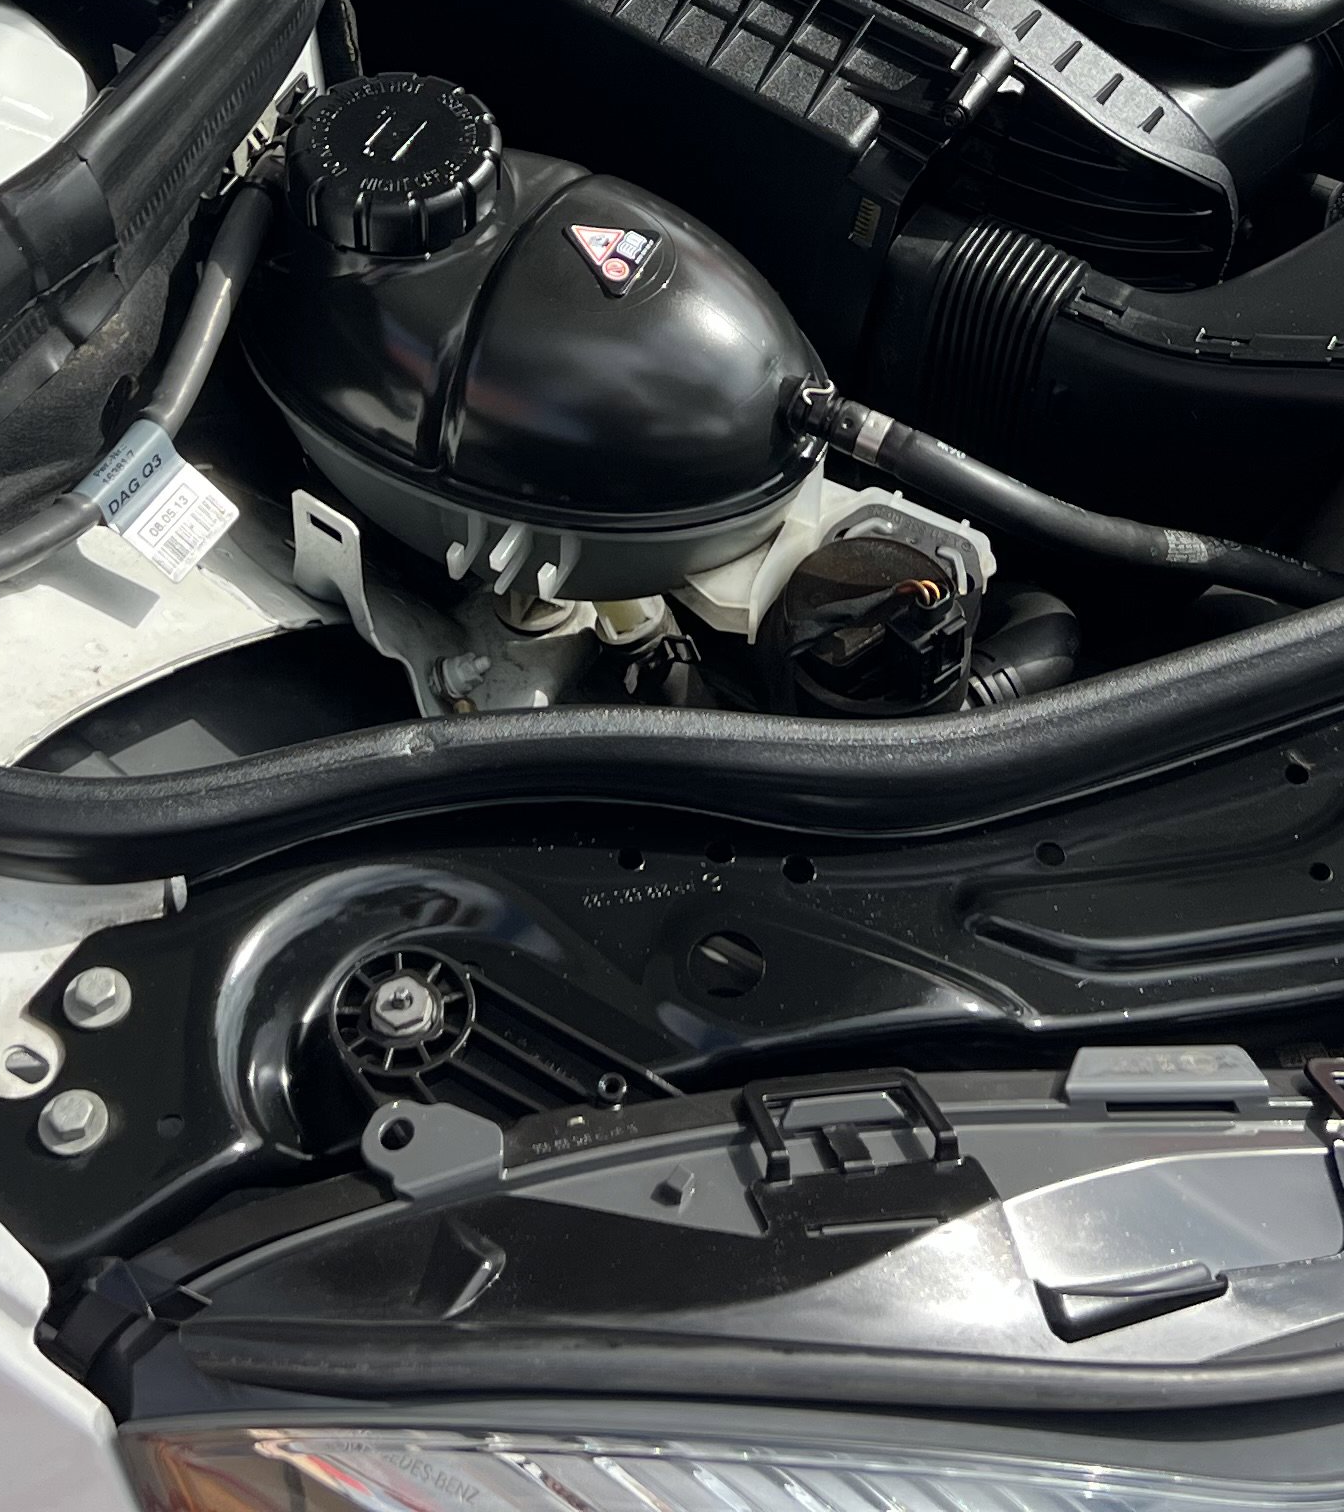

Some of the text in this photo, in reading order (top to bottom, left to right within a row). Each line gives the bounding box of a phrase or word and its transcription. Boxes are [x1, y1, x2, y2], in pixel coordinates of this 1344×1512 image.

[107, 453, 164, 516] DAG Q3
[149, 495, 190, 538] 08.05.13
